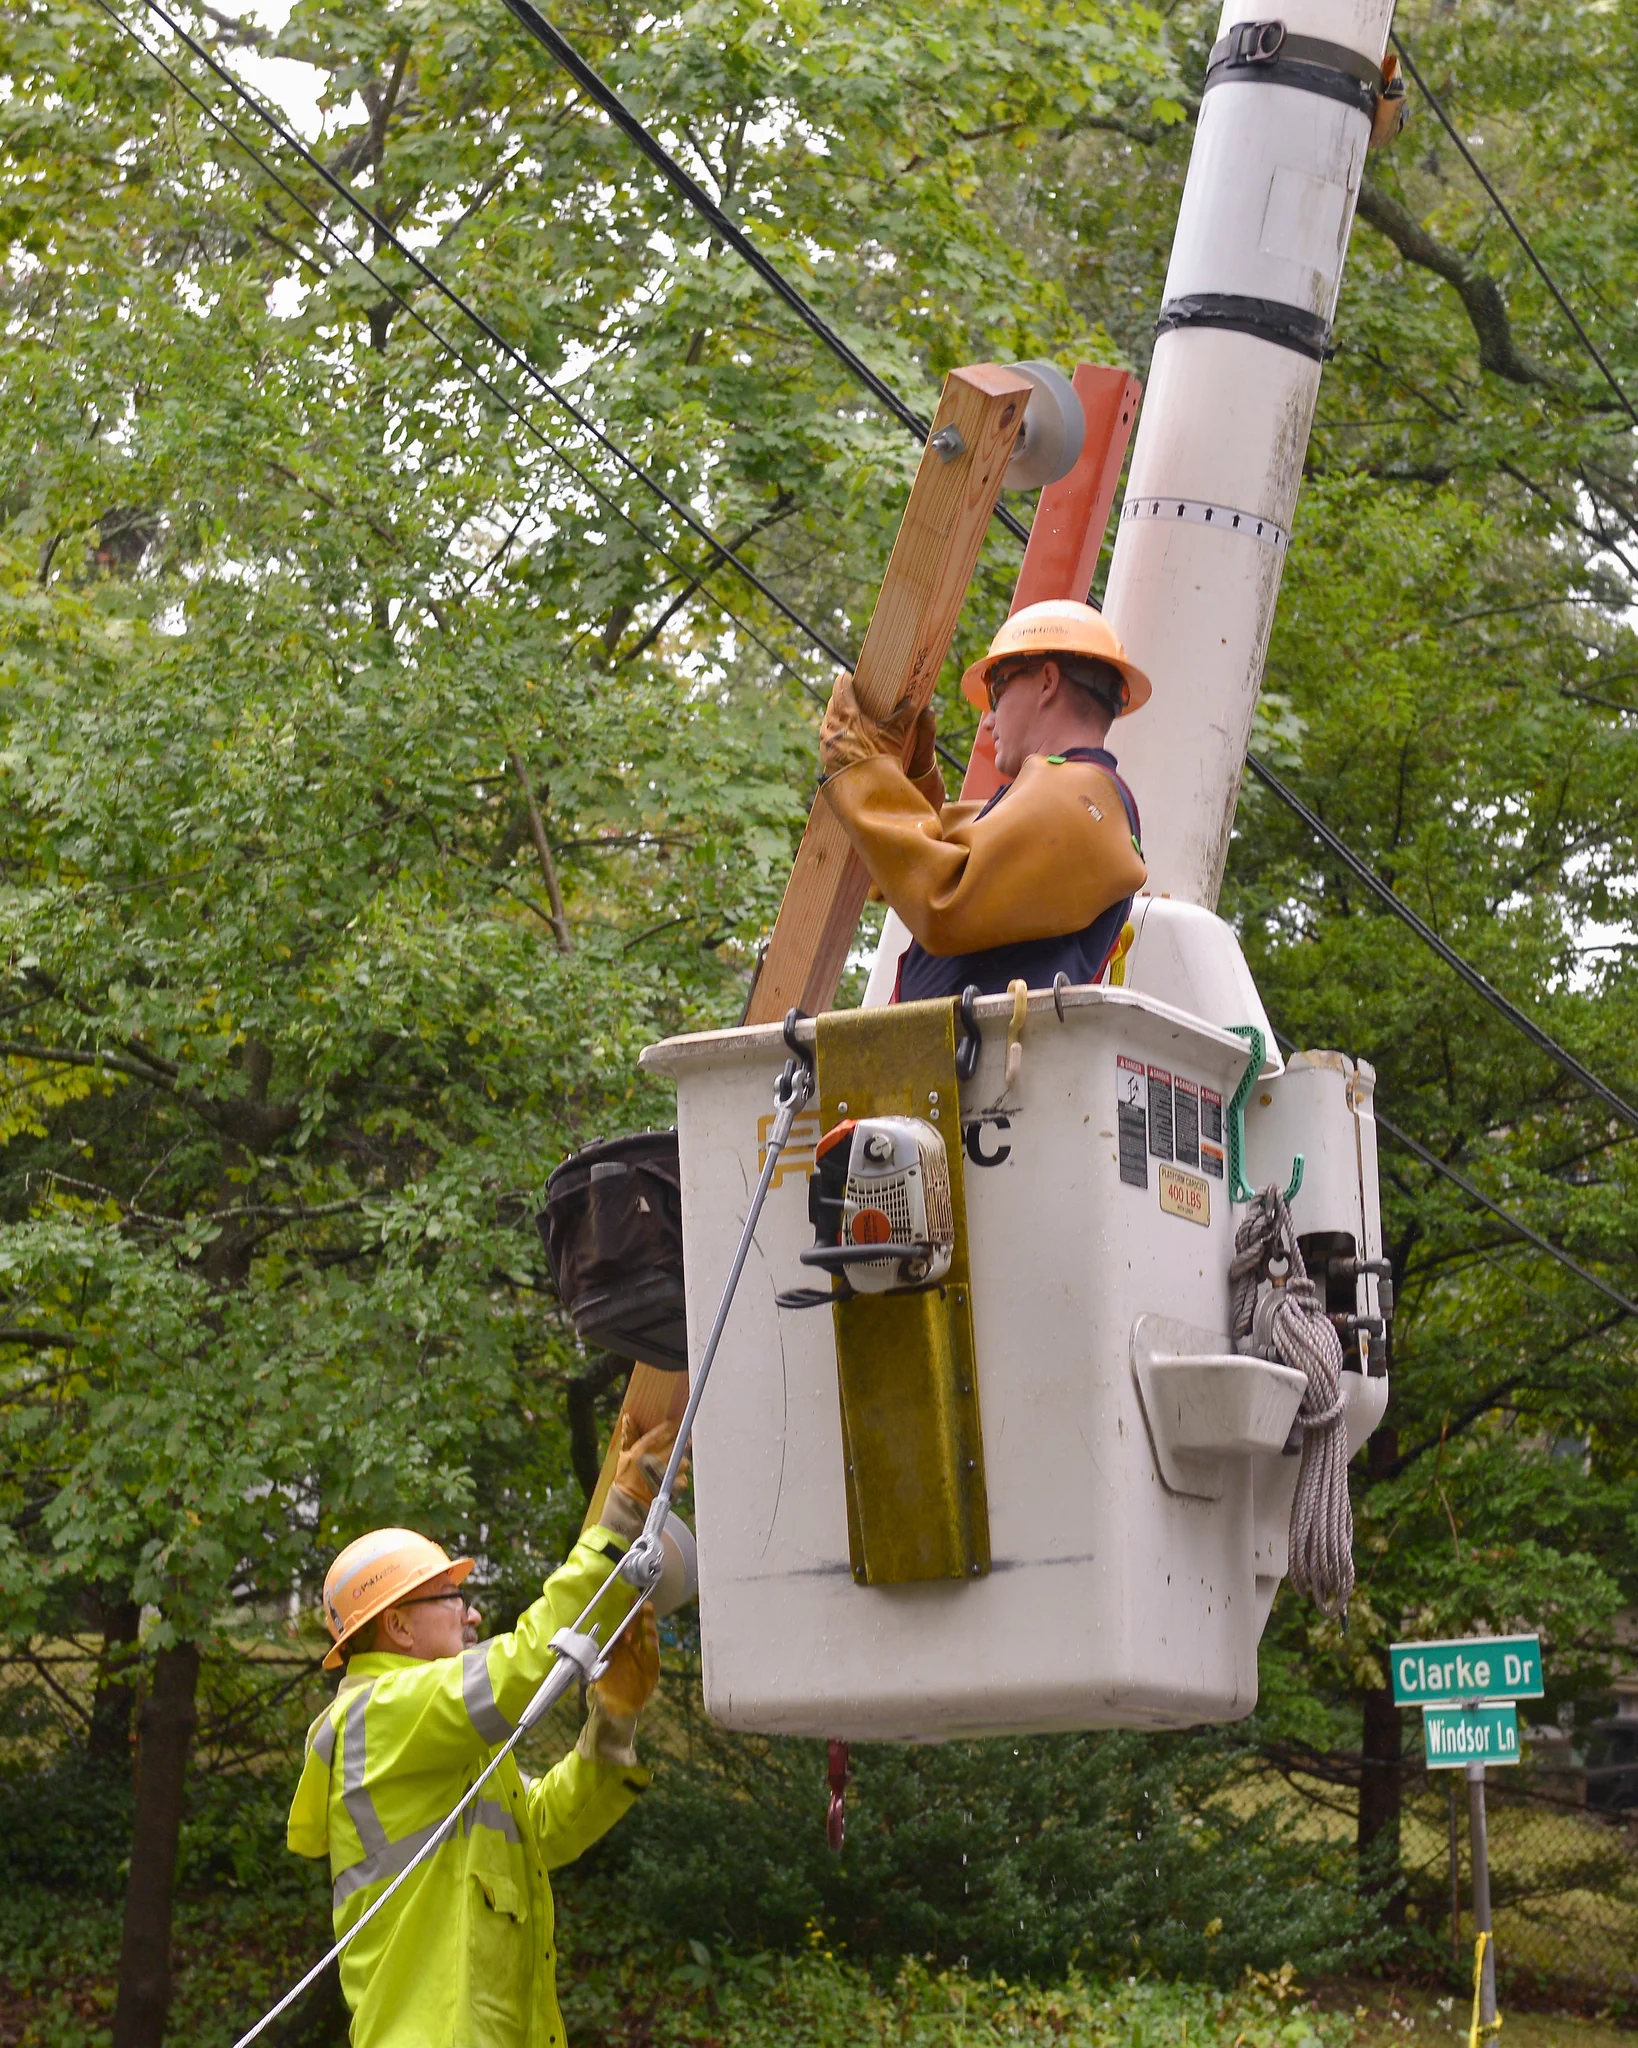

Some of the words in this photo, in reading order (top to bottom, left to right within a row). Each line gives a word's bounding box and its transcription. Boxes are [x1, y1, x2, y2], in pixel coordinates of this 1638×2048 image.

[1168, 1184, 1184, 1203] 400
[1186, 1189, 1202, 1210] LBS
[1400, 1654, 1491, 1692] Clarke
[1504, 1653, 1534, 1686] Dr
[1427, 1718, 1491, 1754] Windsor
[1497, 1719, 1516, 1751] Ln
